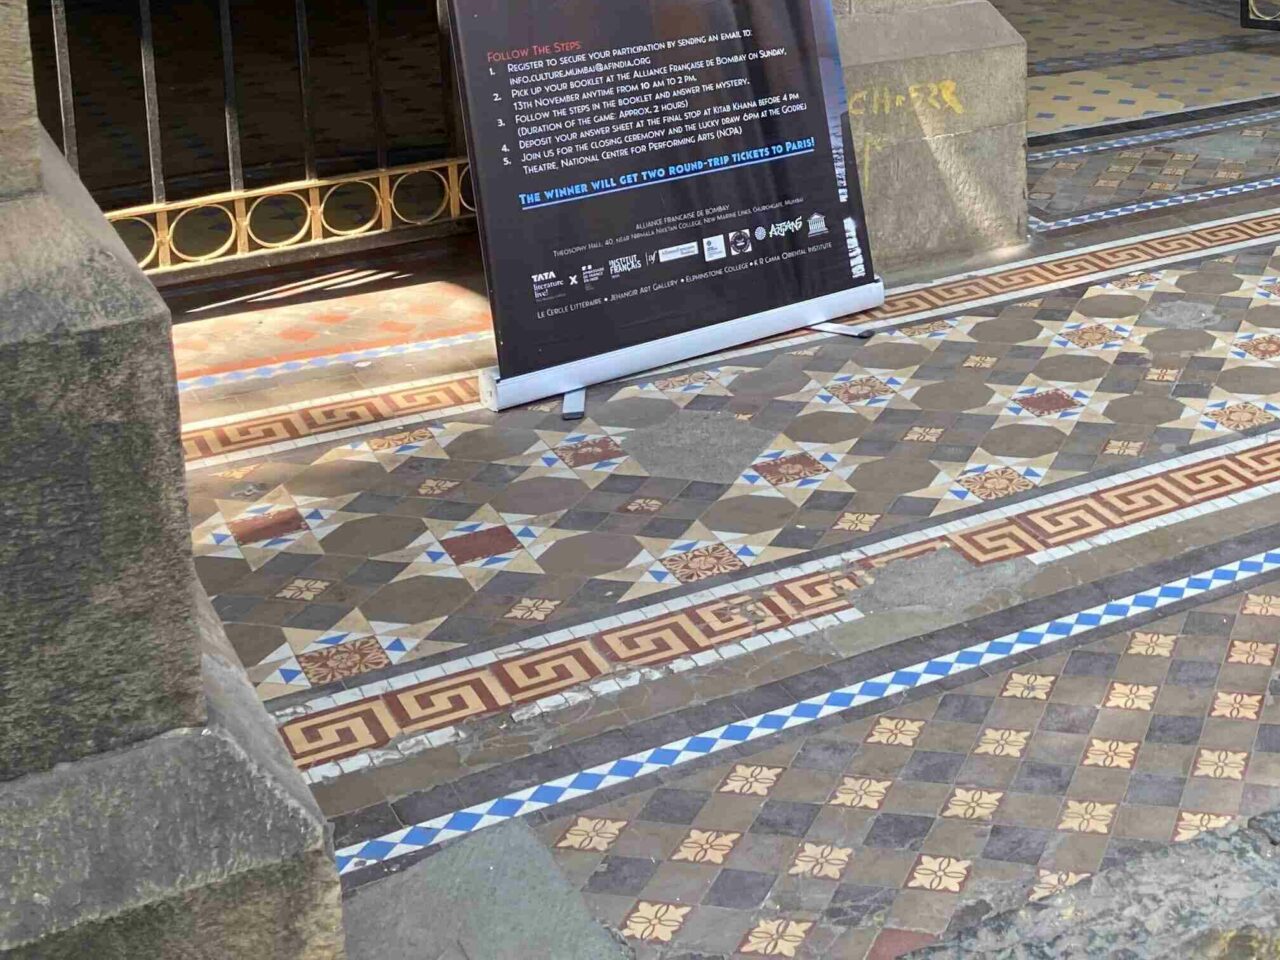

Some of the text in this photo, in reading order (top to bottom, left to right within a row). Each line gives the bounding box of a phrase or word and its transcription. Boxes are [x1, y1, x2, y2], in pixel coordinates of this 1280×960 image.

[487, 41, 581, 62] FOLLOW THE STEPS
[489, 68, 495, 76] 1.
[507, 61, 543, 72] REGISTER
[560, 55, 586, 64] SECURE
[588, 51, 610, 60] YOUR
[612, 42, 665, 56] PARTICIPATION
[667, 40, 676, 49] BY
[678, 35, 706, 46] SENDING
[708, 34, 718, 42] AN
[721, 31, 742, 40] EMAIL
[512, 89, 529, 98] PICK
[531, 87, 542, 95] UP
[545, 83, 567, 92] YOUR
[570, 77, 603, 88] BOOKLET
[617, 71, 630, 80] THE
[633, 66, 667, 79] ALLIANCE
[670, 60, 704, 73] FRANÇAISE
[706, 59, 714, 67] DE
[716, 54, 746, 66] BOMBAY
[748, 52, 758, 60] ON
[759, 48, 787, 57] SUNDAY,
[513, 102, 532, 111] 13TH
[535, 94, 580, 107] NOVEMBER
[582, 88, 614, 100] ANYTIME
[616, 83, 638, 93] FROM
[517, 123, 562, 137] (DURATION
[565, 118, 575, 128] OF
[619, 107, 652, 119] APPROX.
[662, 100, 688, 111] HOURS)
[523, 126, 742, 175] THEATRE, NATIONAL CENTRE FOR PERFORMING ARTS (NCPA)
[519, 137, 815, 204] THE WINNER WILL GET TWO ROUND-TRIP TICKETS TO PARIS!
[696, 209, 703, 217] DE
[705, 205, 729, 215] BOMBAY
[759, 257, 764, 265] R
[533, 280, 564, 291] literature
